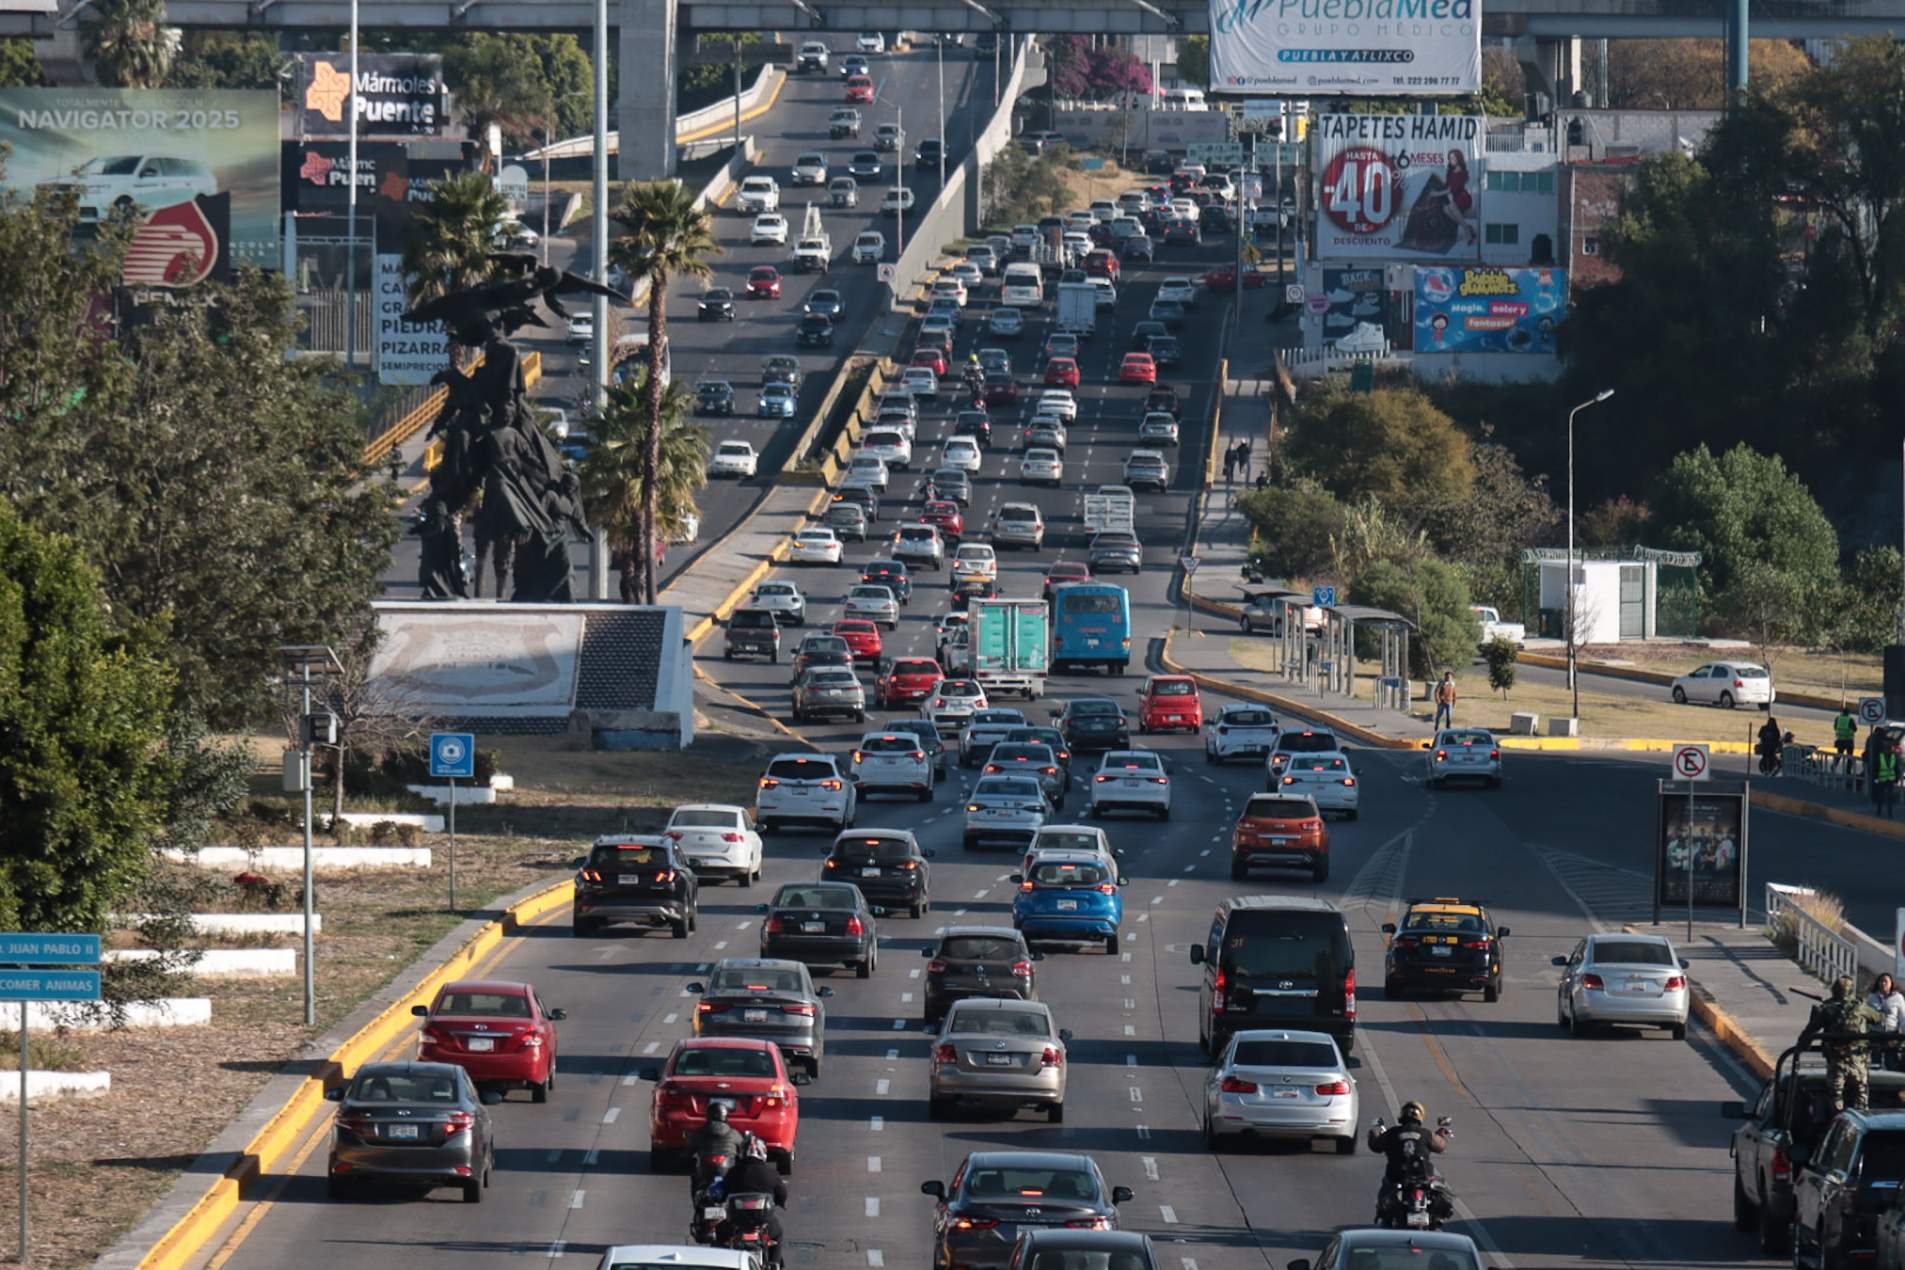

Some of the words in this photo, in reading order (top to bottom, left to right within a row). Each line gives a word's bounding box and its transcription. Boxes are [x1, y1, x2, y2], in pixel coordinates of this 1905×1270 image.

[1277, 23, 1360, 37] GRUPO
[1282, 52, 1337, 62] PUEBLA
[1340, 52, 1349, 61] Y
[1351, 52, 1413, 62] ATLIXCO
[356, 70, 436, 94] Mármoles
[355, 96, 435, 124] Puente
[18, 109, 168, 129] NAVIGATOR
[175, 109, 241, 129] 2025
[1322, 115, 1406, 139] TAPETES
[1411, 117, 1478, 141] HAMID
[1410, 152, 1445, 165] MESES
[1333, 236, 1392, 246] DESCUENTO
[8, 943, 39, 955] JUAN
[43, 944, 81, 955] PABLO
[45, 980, 93, 992] ANIMAS
